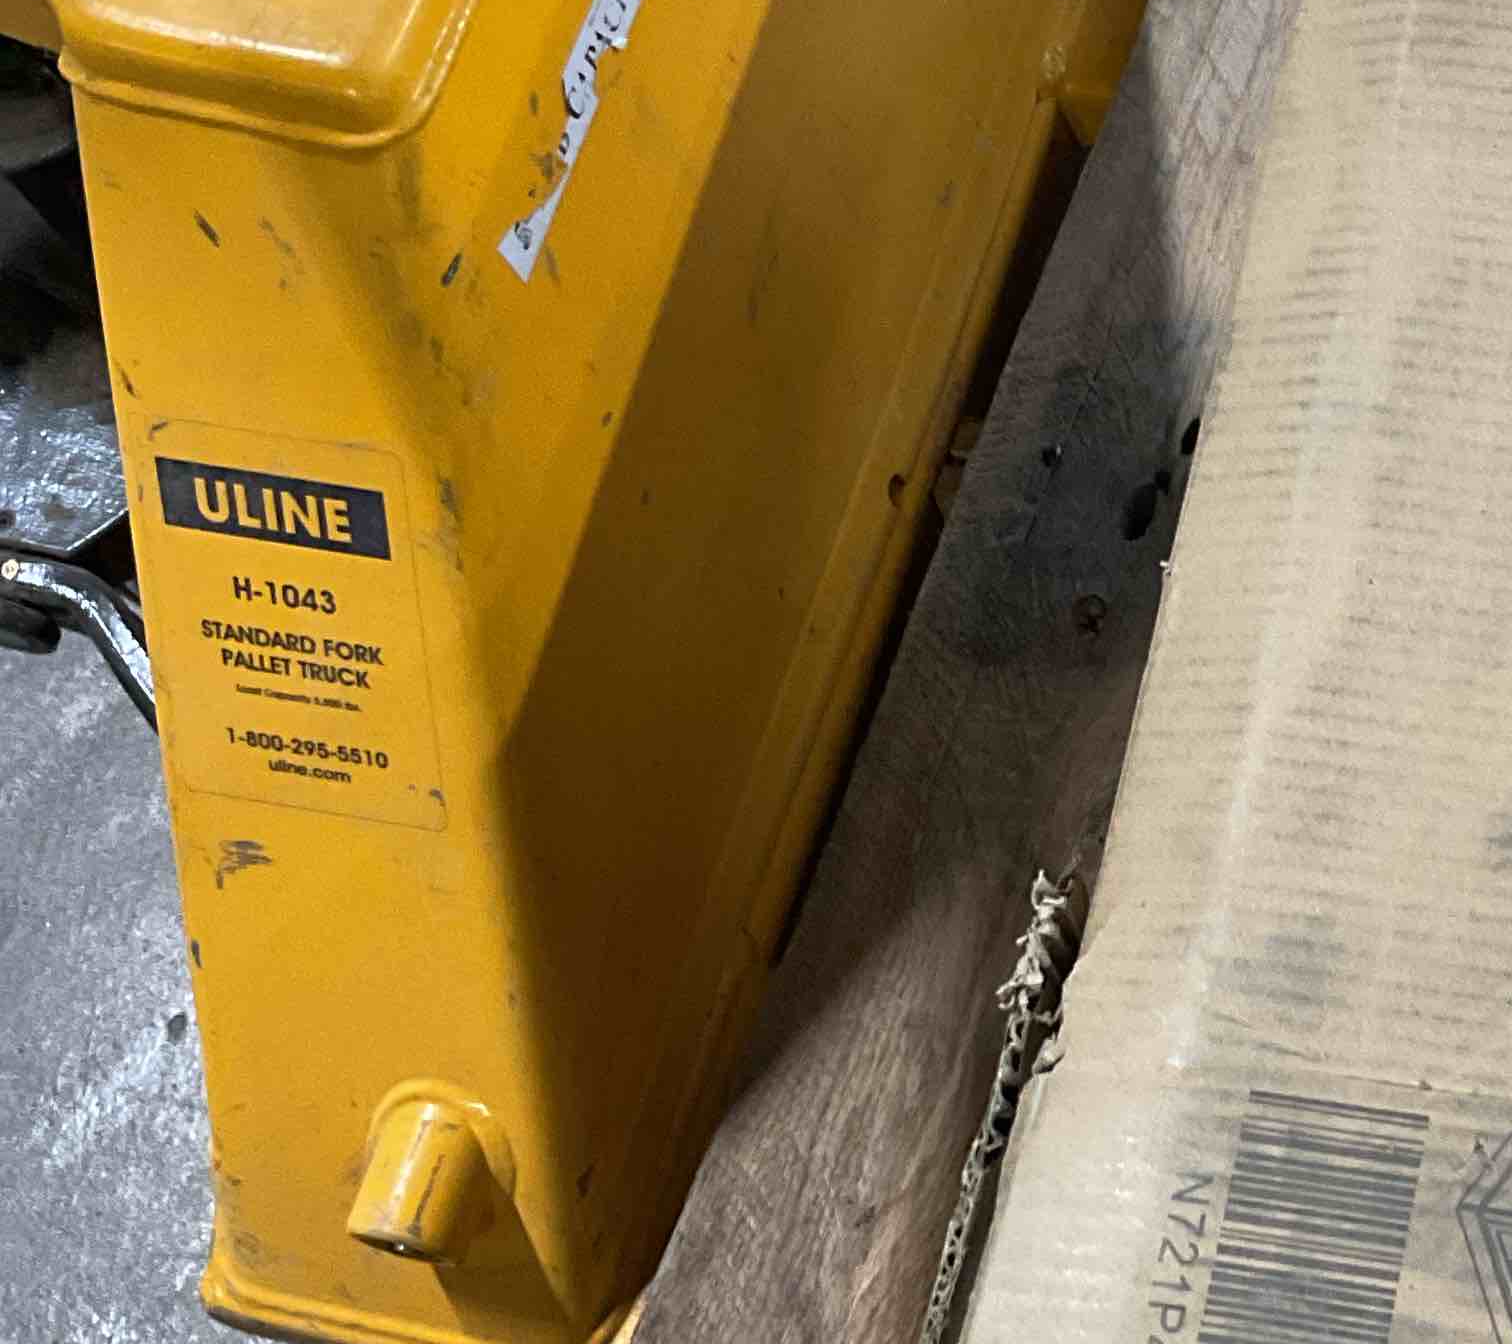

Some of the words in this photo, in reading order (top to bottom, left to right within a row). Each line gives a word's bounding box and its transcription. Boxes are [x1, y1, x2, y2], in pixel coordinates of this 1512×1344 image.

[194, 476, 352, 543] ULINE
[233, 576, 336, 615] H-1043
[201, 619, 316, 655] STANDARD
[323, 638, 383, 666] FORK
[222, 649, 291, 677] PALLET
[300, 661, 370, 689] TRUCK
[227, 727, 388, 769] 1-800-295-5510
[269, 758, 351, 784] uline.com
